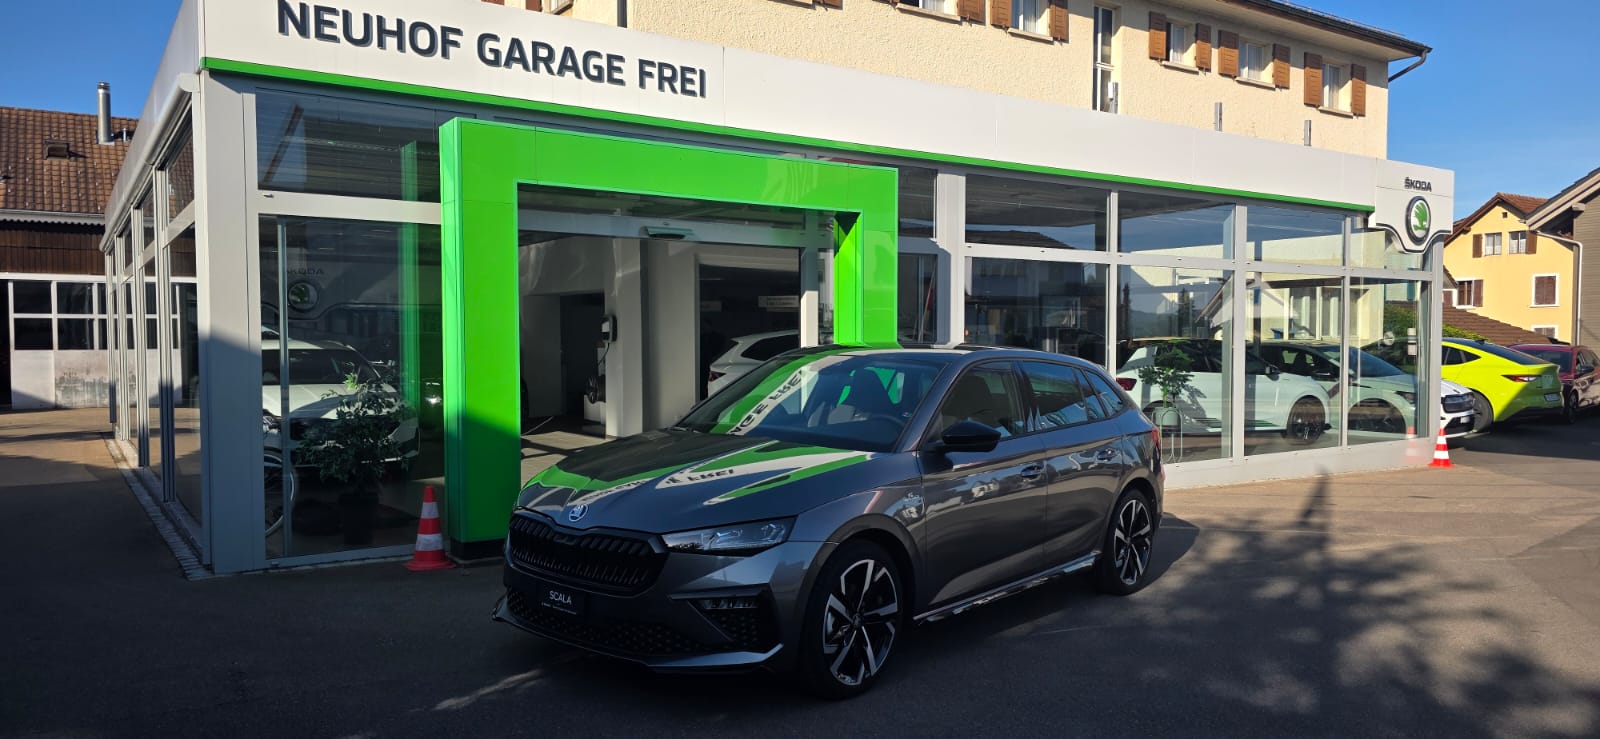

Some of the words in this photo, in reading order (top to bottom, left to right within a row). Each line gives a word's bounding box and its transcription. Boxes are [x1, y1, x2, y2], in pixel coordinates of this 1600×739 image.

[277, 0, 463, 59] NEUHOF
[476, 32, 625, 86] GARAGE
[637, 58, 707, 98] FREI
[1404, 177, 1432, 192] ŠKODA
[549, 590, 572, 605] SCALA
